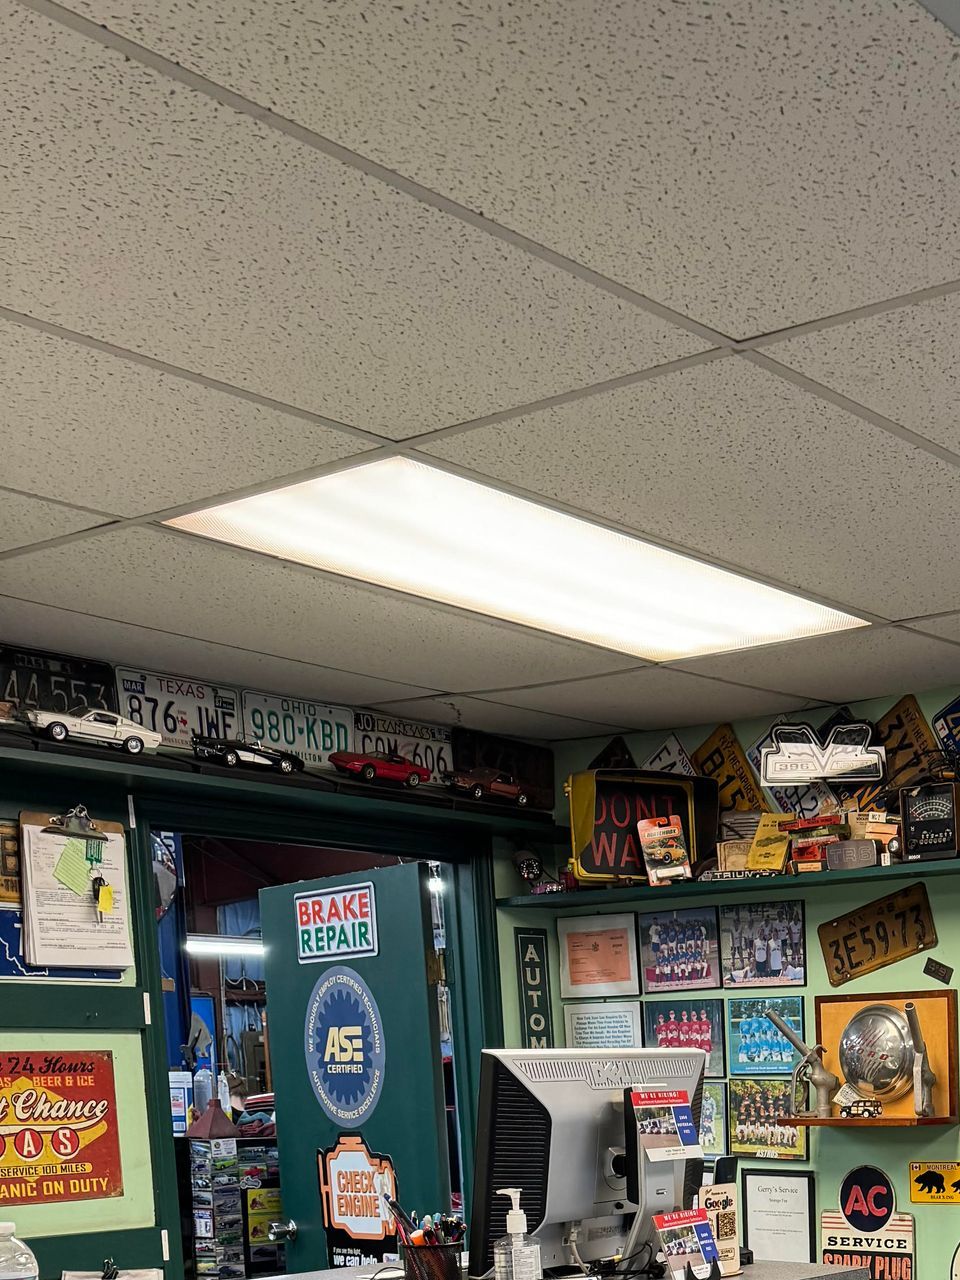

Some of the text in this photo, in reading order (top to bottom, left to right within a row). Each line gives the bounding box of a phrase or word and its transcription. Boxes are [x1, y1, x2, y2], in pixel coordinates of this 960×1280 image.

[156, 678, 205, 699] TEXAS
[128, 694, 235, 741] 876 JWF
[281, 700, 316, 716] OHIO
[252, 707, 348, 752] 980 KBD
[376, 718, 432, 741] KANSAS
[830, 847, 873, 863] TR6
[298, 892, 370, 926] BRAKE
[301, 921, 371, 954] REPAIR
[324, 1026, 363, 1062] ASE
[8, 1056, 95, 1074] 24 Hours
[327, 1064, 363, 1074] CERTIFIED
[33, 1076, 95, 1086] BEER & ICE
[11, 1089, 109, 1122] Chance
[1, 1164, 86, 1177] SERVICE 100 MILES
[43, 1178, 109, 1195] ON DUTY
[337, 1170, 377, 1193] CHECK
[757, 1186, 798, 1194] Gerry's Service
[337, 1195, 380, 1218] ENGINE
[705, 1196, 734, 1210] Google
[844, 1185, 888, 1217] AC
[827, 1237, 907, 1249] SERVICE
[334, 1255, 360, 1267] we can
